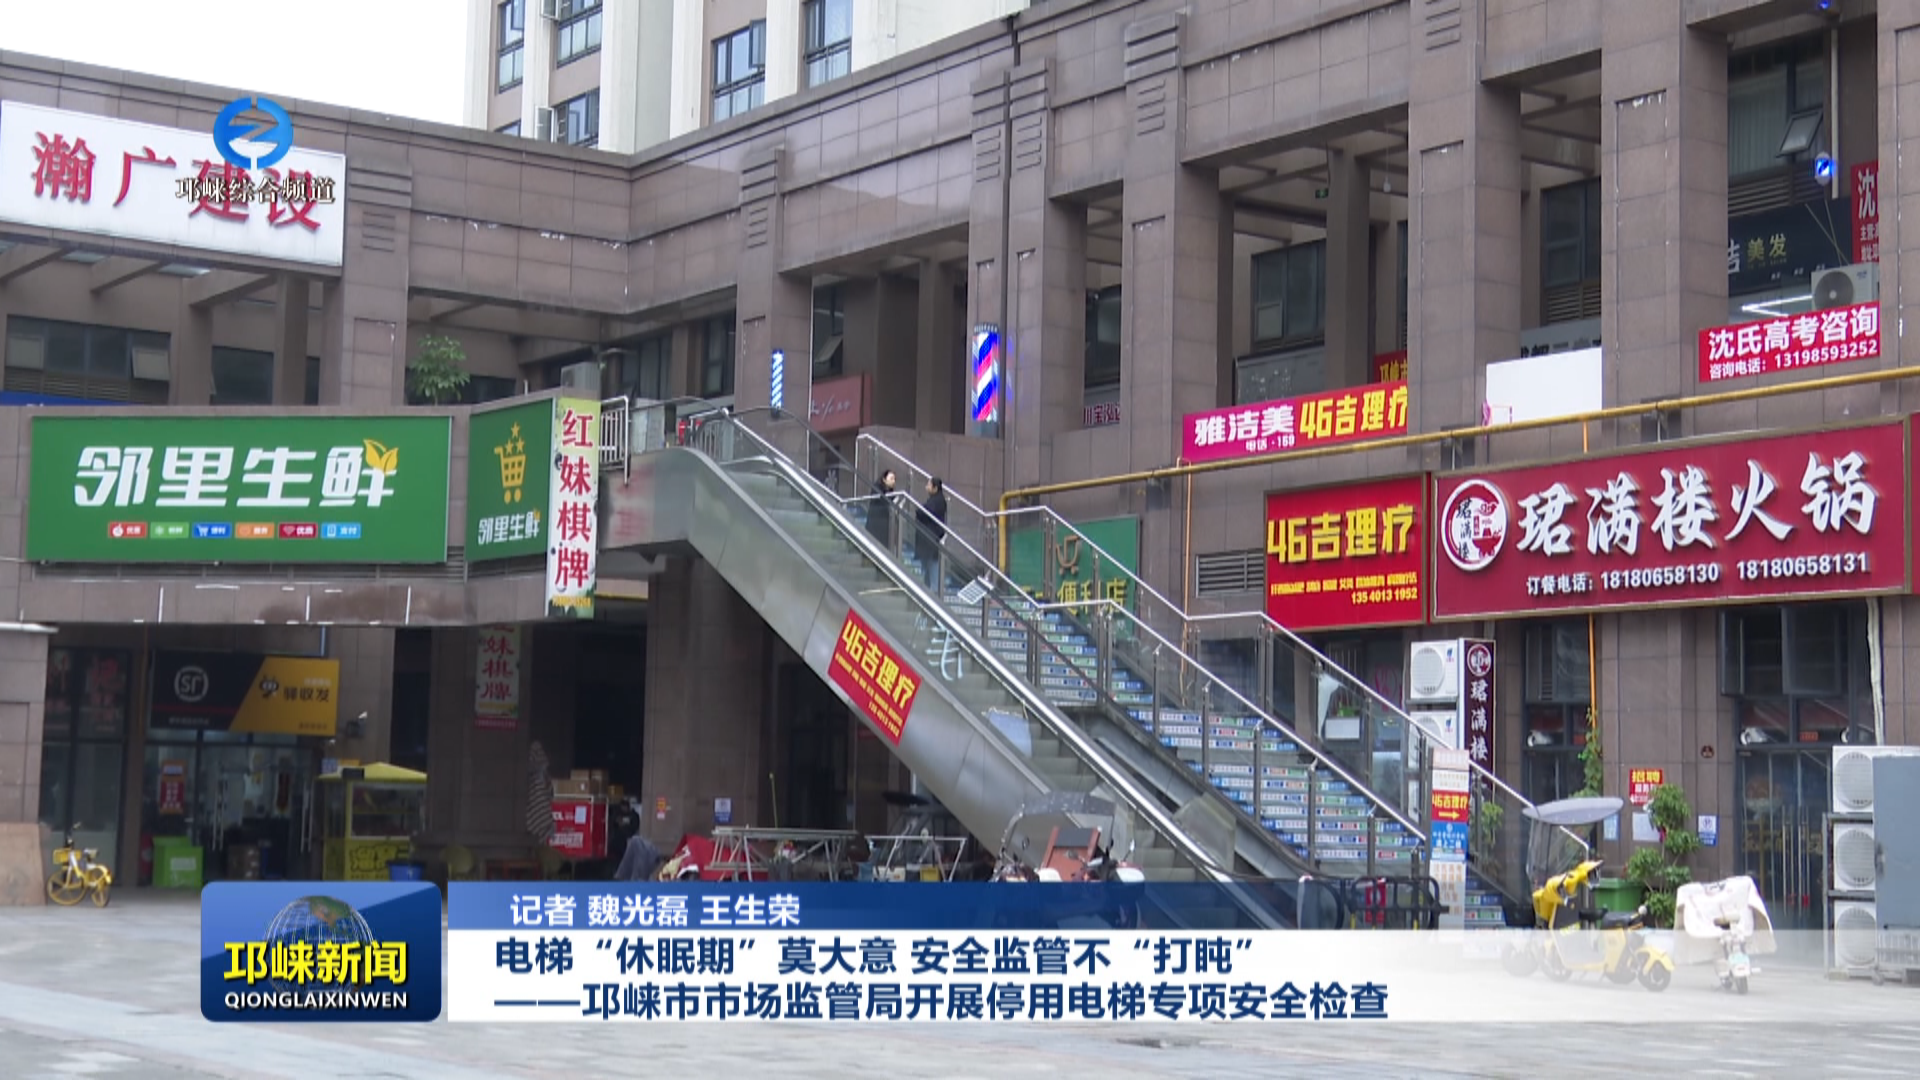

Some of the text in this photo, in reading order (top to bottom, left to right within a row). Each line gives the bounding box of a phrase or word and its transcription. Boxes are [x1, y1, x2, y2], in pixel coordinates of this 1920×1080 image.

[32, 131, 322, 231] 瀚广建设
[1858, 168, 1879, 219] 沈
[1708, 305, 1878, 361] 沈氏高考咨询
[1774, 340, 1878, 368] 13198593252
[1194, 385, 1407, 446] 雅洁美 46吉理疗
[74, 445, 398, 507] 邻里生鲜
[555, 409, 593, 588] 红妹棋牌
[1515, 450, 1880, 556] 珺满楼火锅
[478, 511, 540, 545] 邻里生鲜
[1267, 503, 1415, 564] 46吉理疗
[1600, 563, 1719, 591] 18180658130
[1736, 551, 1869, 580] 18180658131
[481, 625, 514, 700] 妹棋牌
[841, 619, 916, 709] 46吉理疗
[1470, 679, 1489, 761] 珺满楼
